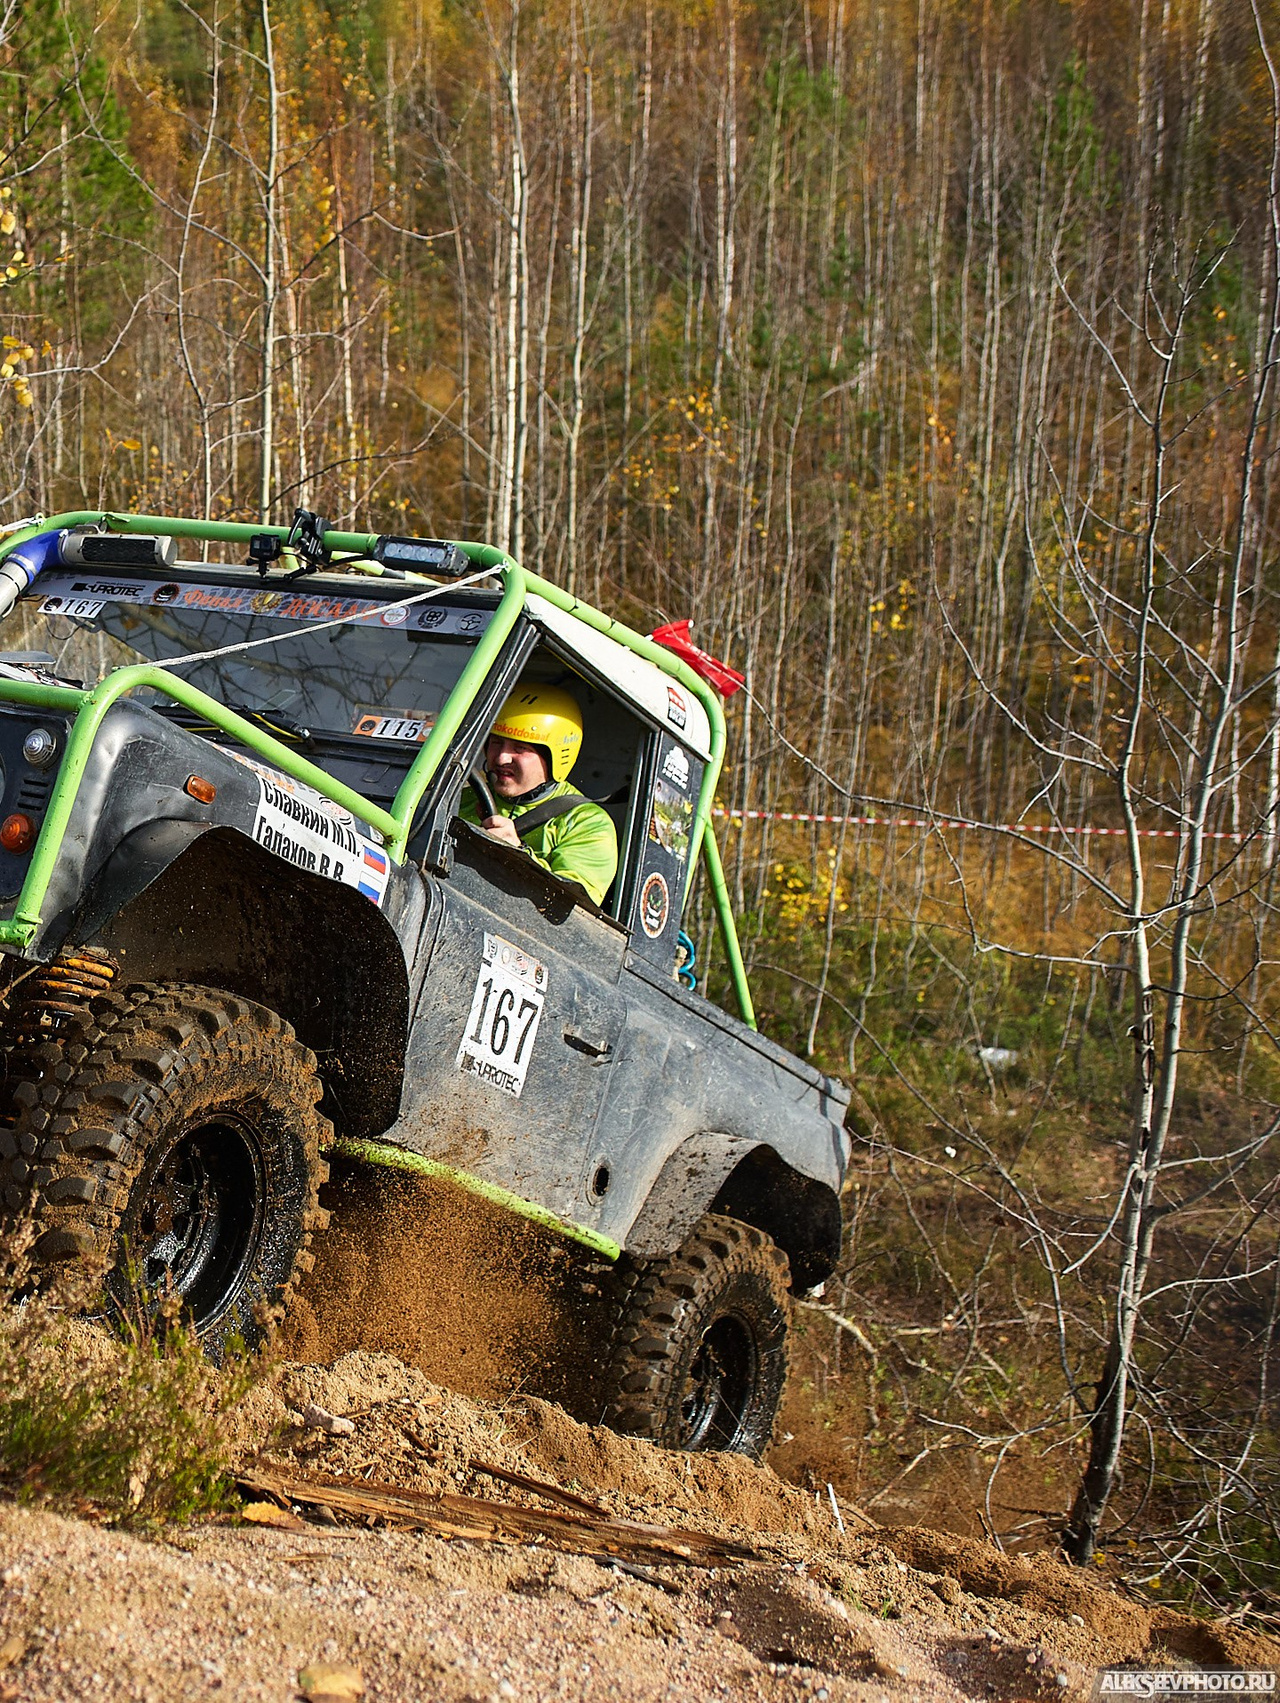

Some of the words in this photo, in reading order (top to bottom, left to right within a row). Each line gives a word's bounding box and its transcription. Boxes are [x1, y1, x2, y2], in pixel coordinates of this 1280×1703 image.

[61, 599, 102, 616] 167
[377, 719, 421, 739] 115
[261, 778, 329, 838] Славкин
[469, 977, 539, 1065] 167
